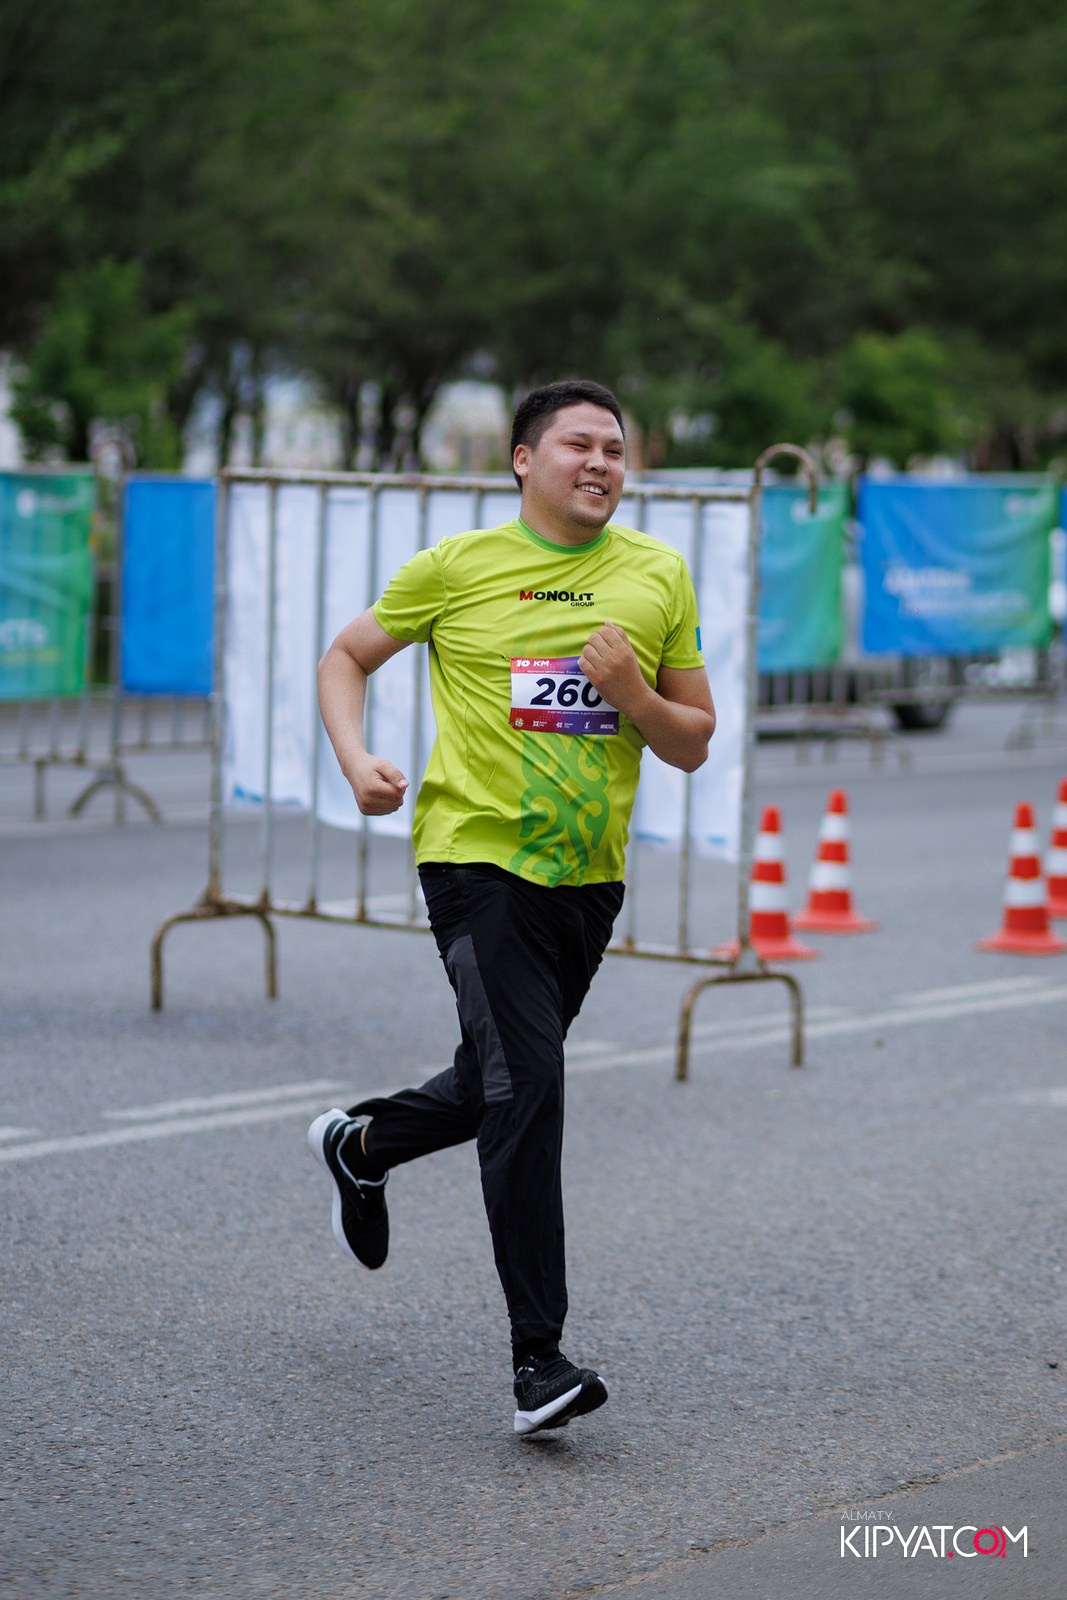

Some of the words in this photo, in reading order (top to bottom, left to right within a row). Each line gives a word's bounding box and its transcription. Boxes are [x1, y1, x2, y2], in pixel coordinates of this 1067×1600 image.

[519, 590, 594, 601] MONOLIT
[516, 659, 531, 667] 10
[530, 677, 603, 708] 260
